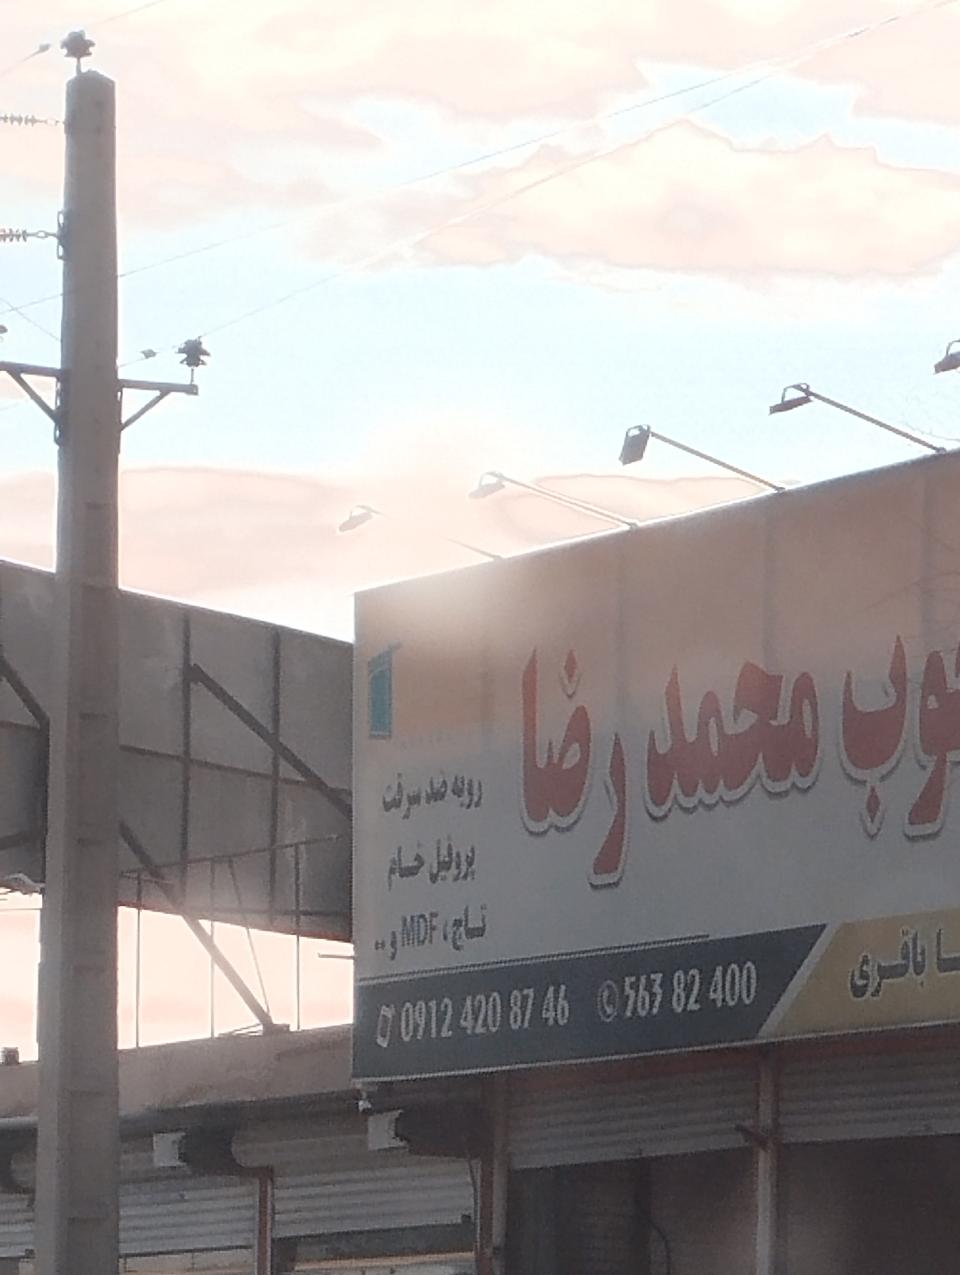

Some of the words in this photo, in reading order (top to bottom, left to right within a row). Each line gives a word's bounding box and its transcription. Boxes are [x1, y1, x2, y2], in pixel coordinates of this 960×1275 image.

[429, 836, 476, 884] پروفیل
[402, 911, 439, 948] MDF
[624, 972, 663, 1018] 563
[673, 968, 701, 1013] 82
[710, 961, 757, 1007] 400
[850, 929, 926, 998] باقری
[401, 998, 453, 1042] 0912
[460, 992, 500, 1034] 420
[510, 988, 534, 1030] 87
[542, 984, 570, 1026] 46
